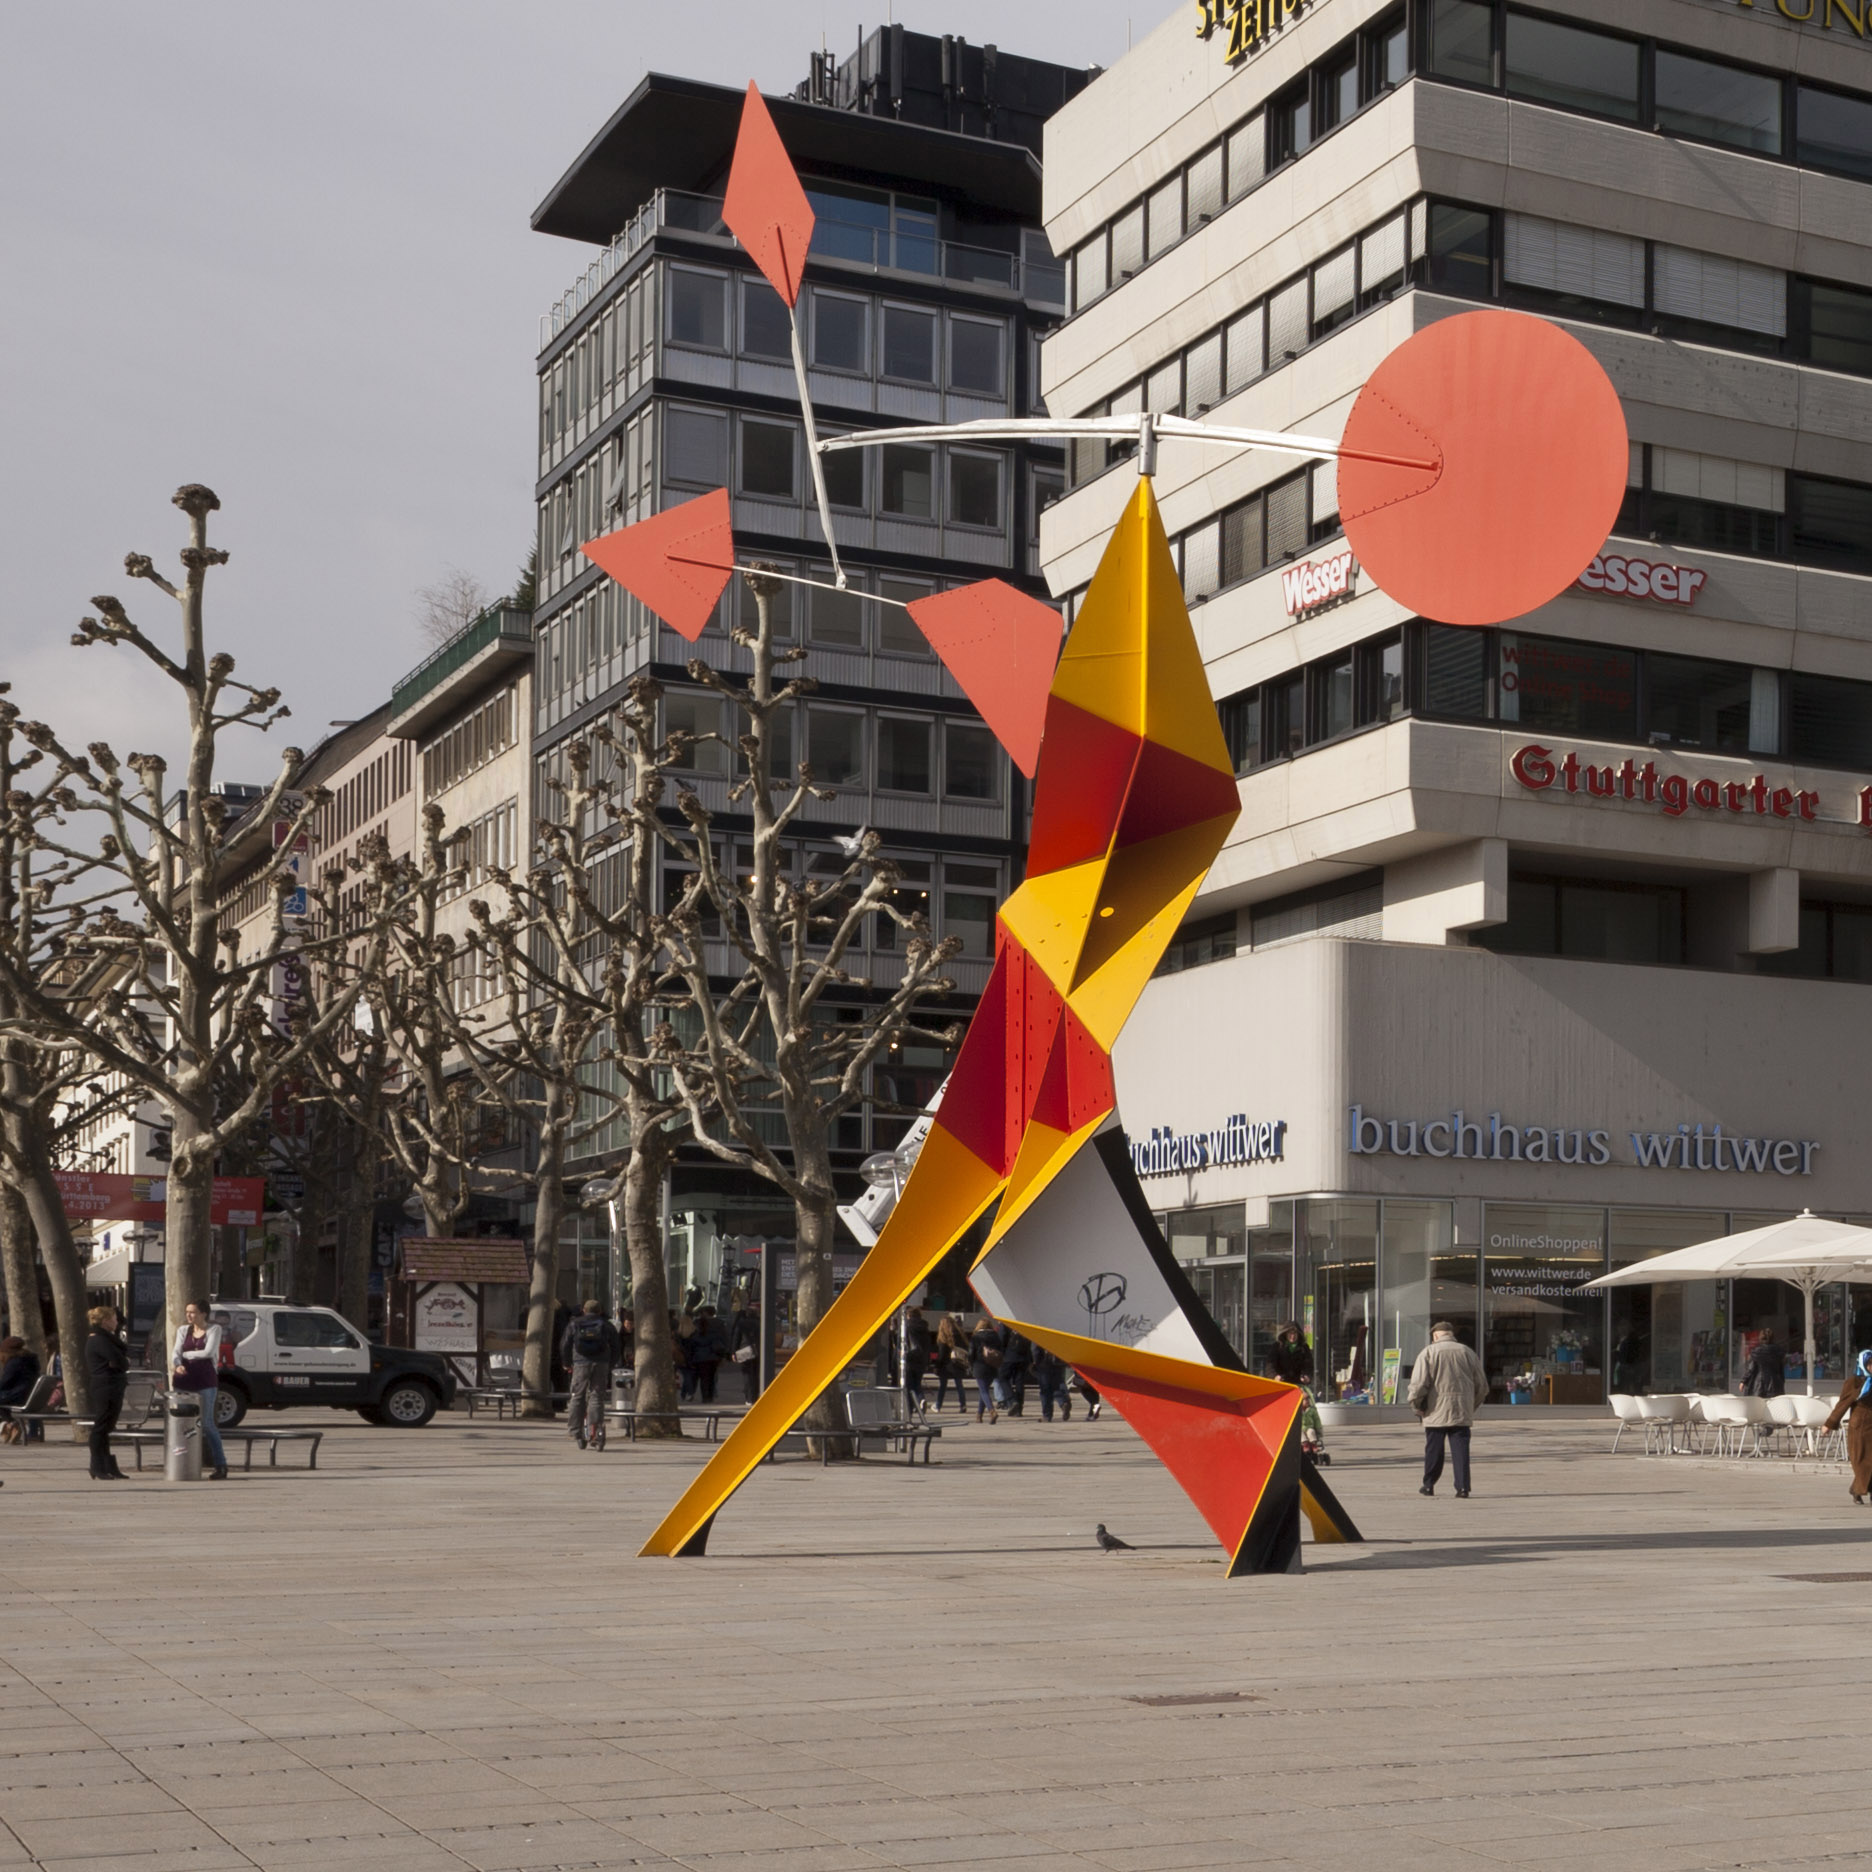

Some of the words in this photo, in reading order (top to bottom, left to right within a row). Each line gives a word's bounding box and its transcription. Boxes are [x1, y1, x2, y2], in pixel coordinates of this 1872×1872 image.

[1282, 550, 1354, 616] Wesser
[1574, 554, 1708, 607] esser
[1508, 744, 1820, 819] Stuttgarter
[1128, 1126, 1208, 1176] uchhaus
[1206, 1113, 1284, 1165] wittwer
[1348, 1105, 1610, 1165] buchhaus
[1631, 1123, 1821, 1176] wittwer
[54, 1173, 91, 1183] ünstler
[61, 1193, 111, 1205] ürttemberg
[1490, 1234, 1603, 1253] OnlineShoppen!
[1491, 1267, 1592, 1280] www.wittwer.de
[283, 1376, 310, 1386] BAUER
